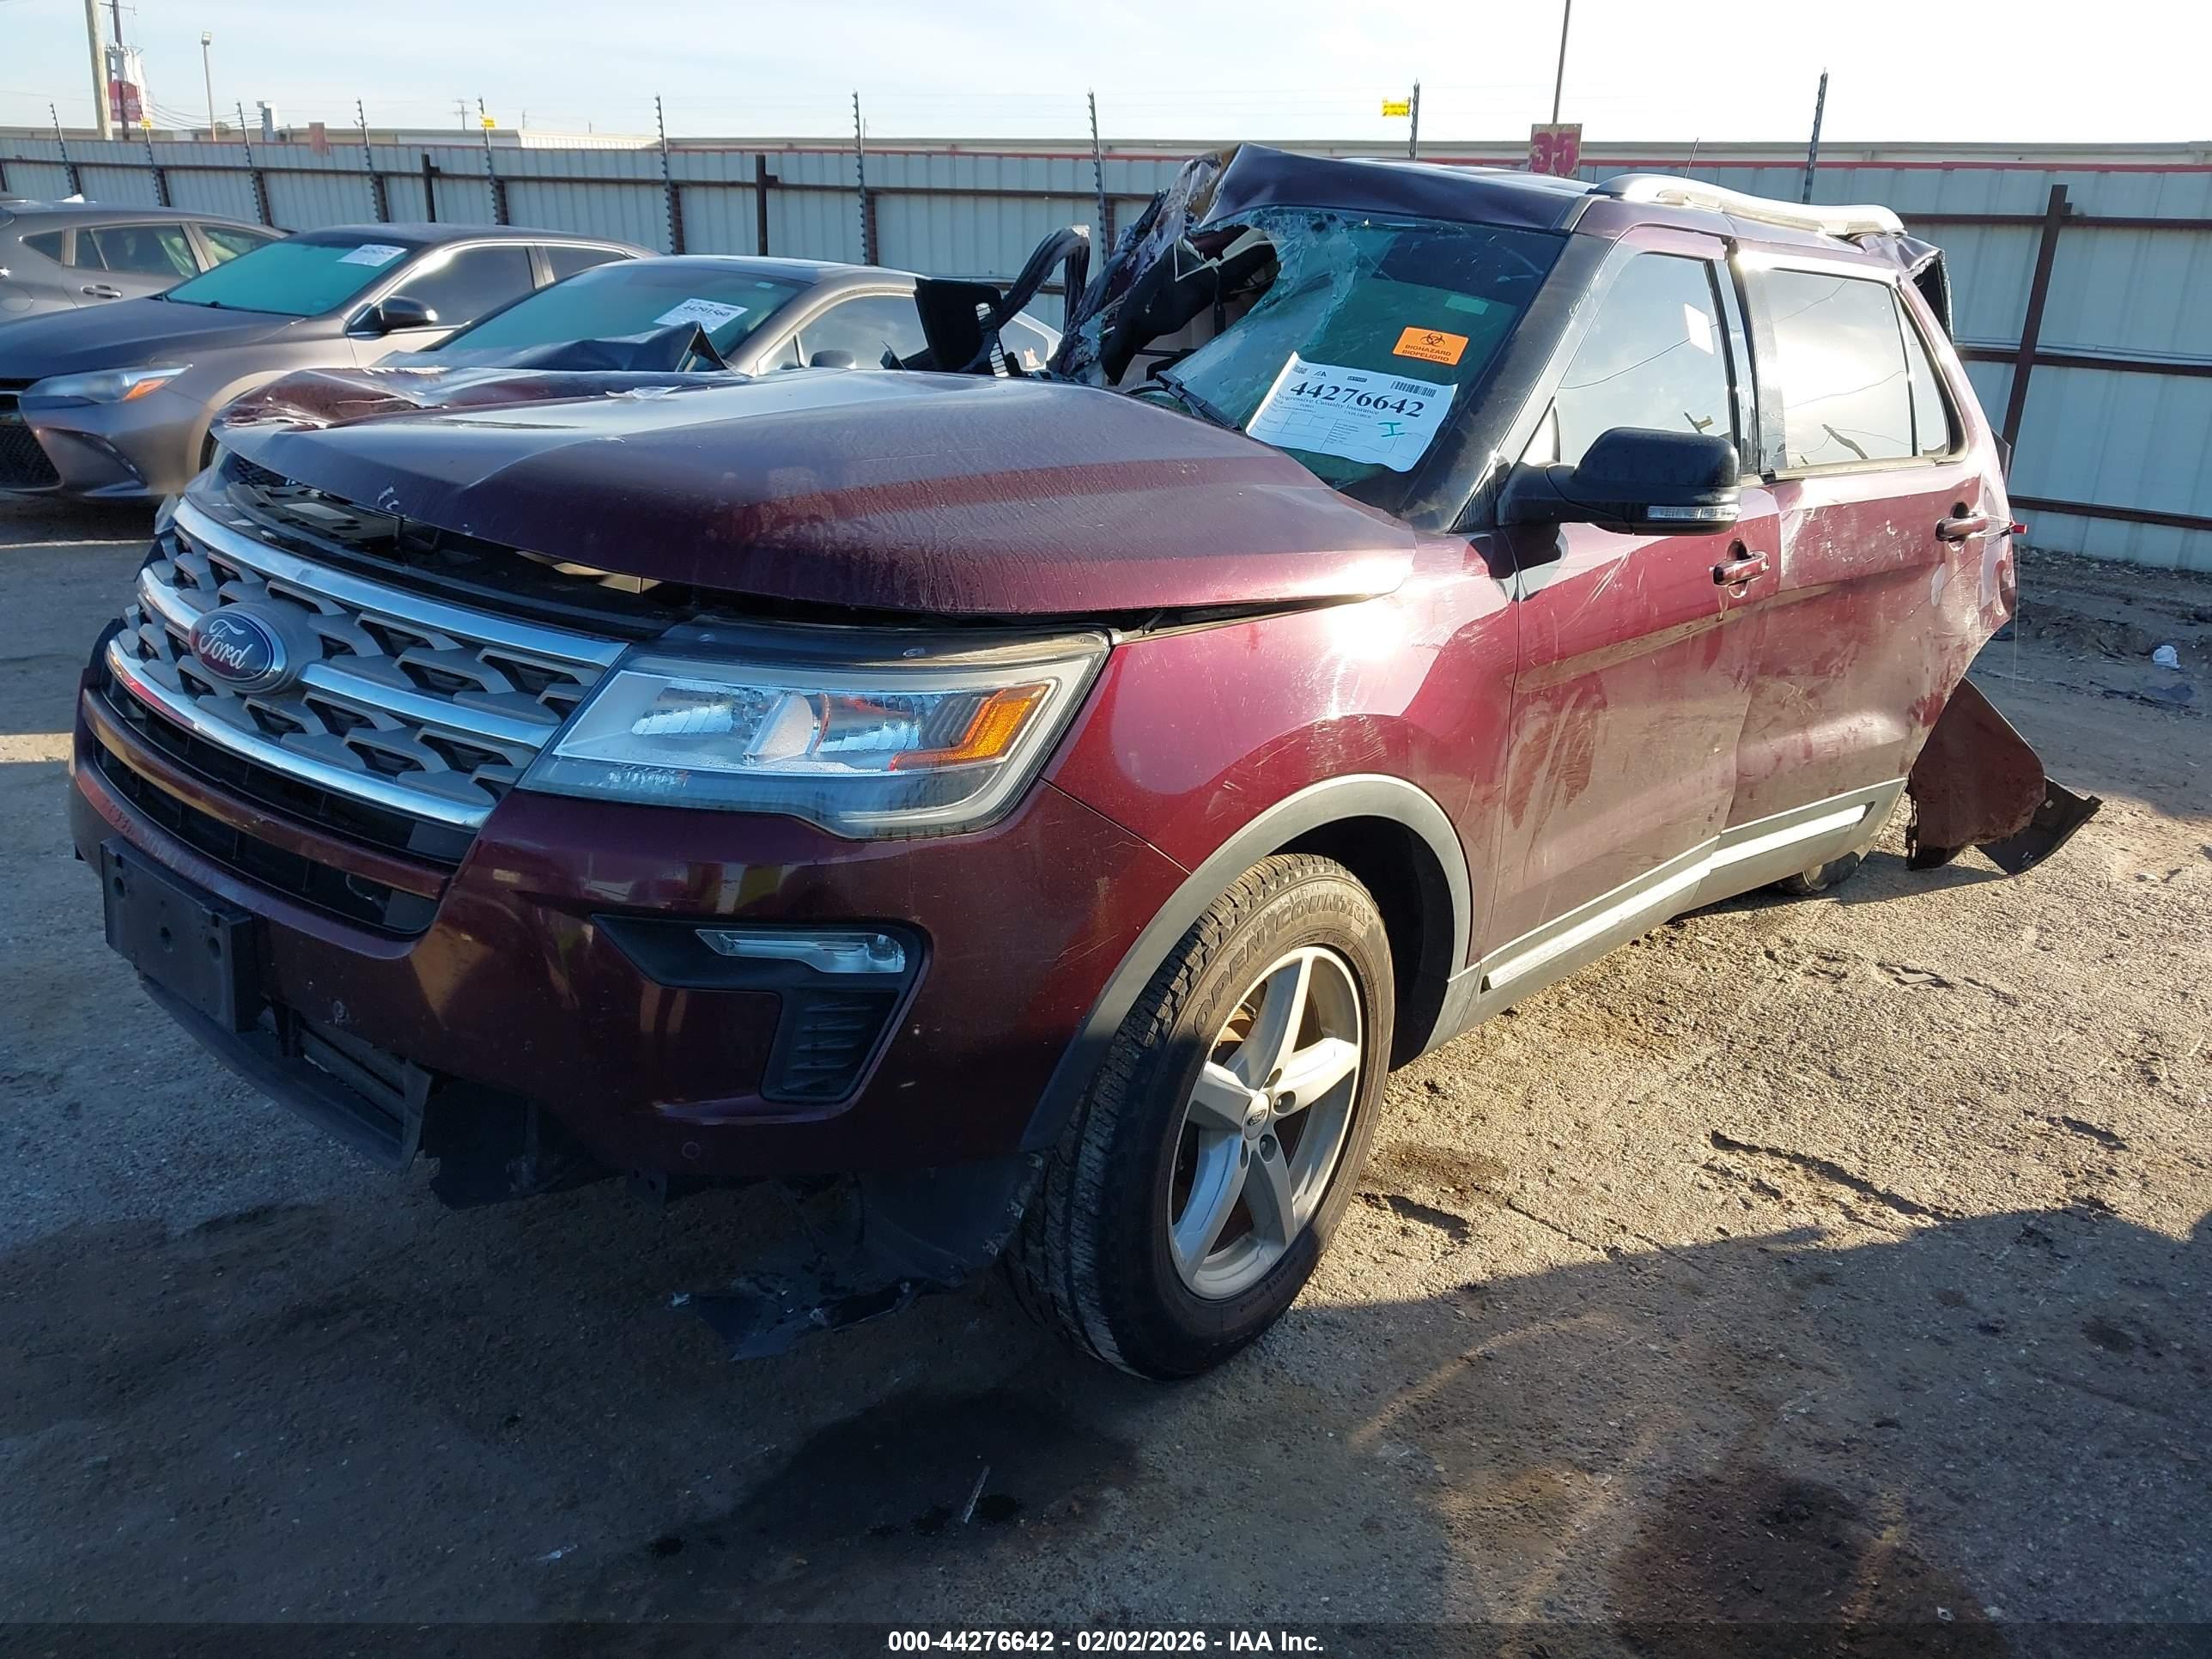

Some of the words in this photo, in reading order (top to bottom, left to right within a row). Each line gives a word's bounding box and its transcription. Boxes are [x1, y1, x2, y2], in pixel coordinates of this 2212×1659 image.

[1401, 349, 1449, 362] BIOPELIGRO
[1405, 343, 1451, 356] BIOHAZARD
[1277, 392, 1314, 404] Progressive
[1315, 399, 1344, 409] Casualty
[1346, 404, 1379, 415] Insurance
[1290, 381, 1425, 418] 44276642
[198, 618, 254, 670] Ford
[1194, 926, 1267, 1036] OPEN
